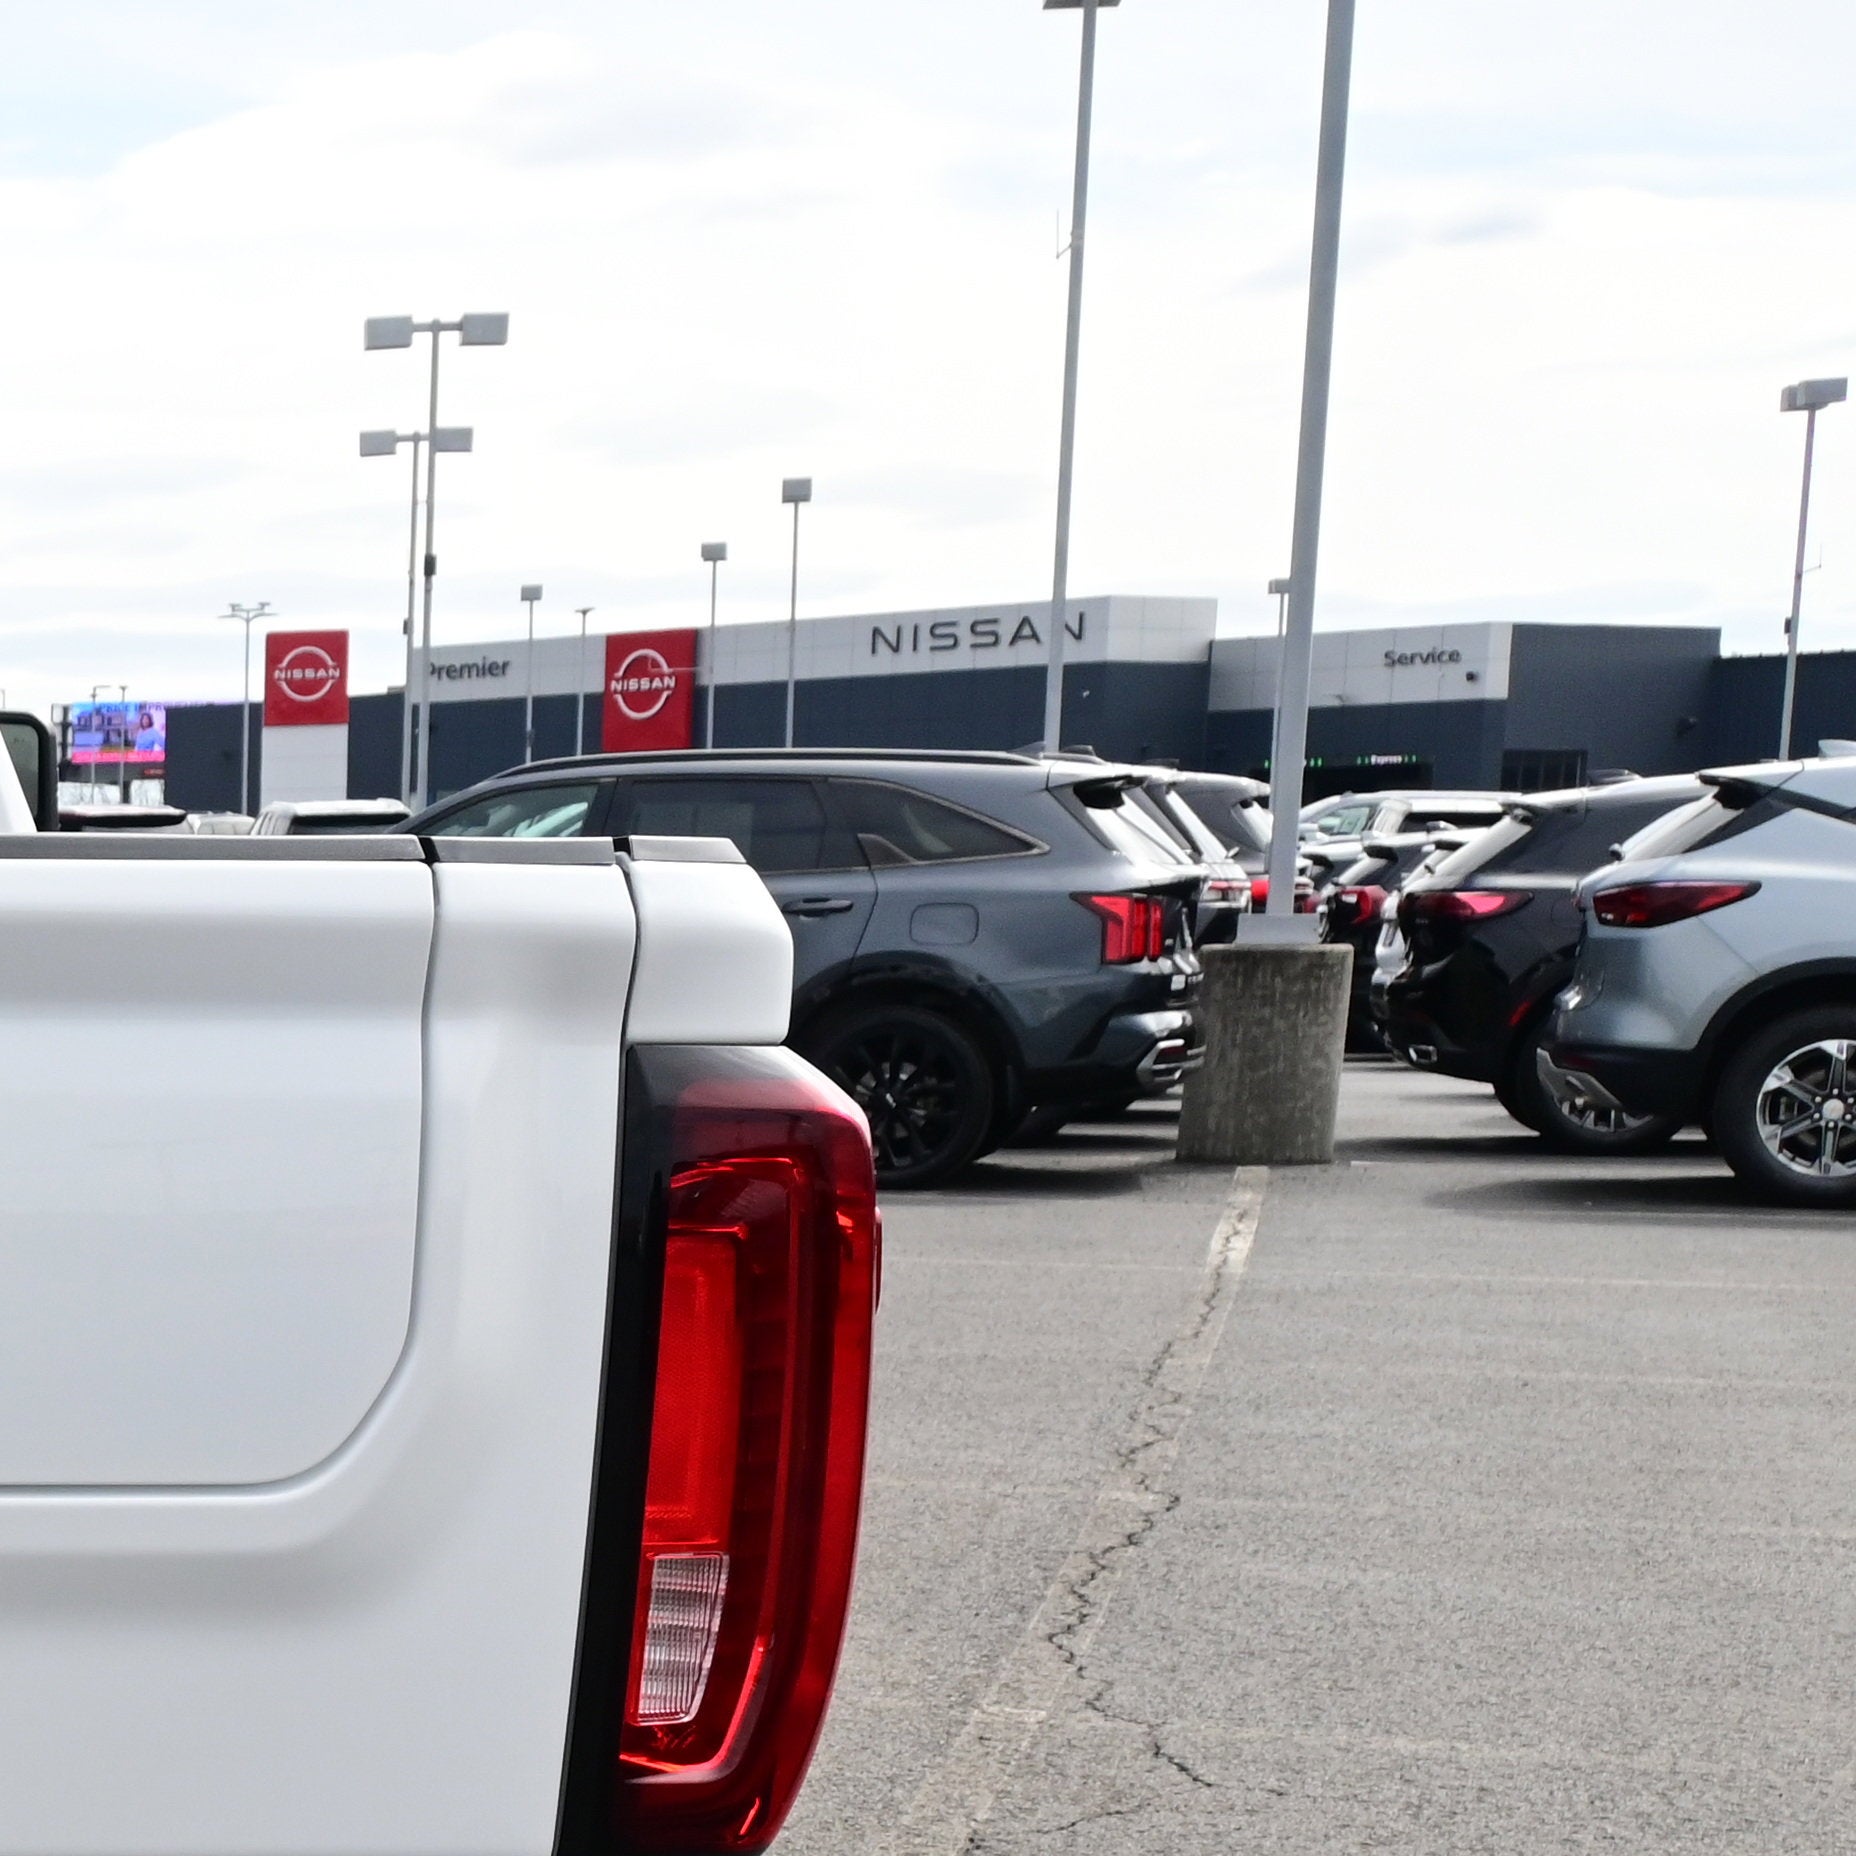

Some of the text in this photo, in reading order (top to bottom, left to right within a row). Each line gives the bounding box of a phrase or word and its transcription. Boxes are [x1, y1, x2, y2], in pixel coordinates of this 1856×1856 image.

[871, 611, 1085, 655] NISSAN
[1384, 647, 1462, 667] Service
[274, 667, 340, 679] NISSAN
[610, 676, 676, 692] NISSAN
